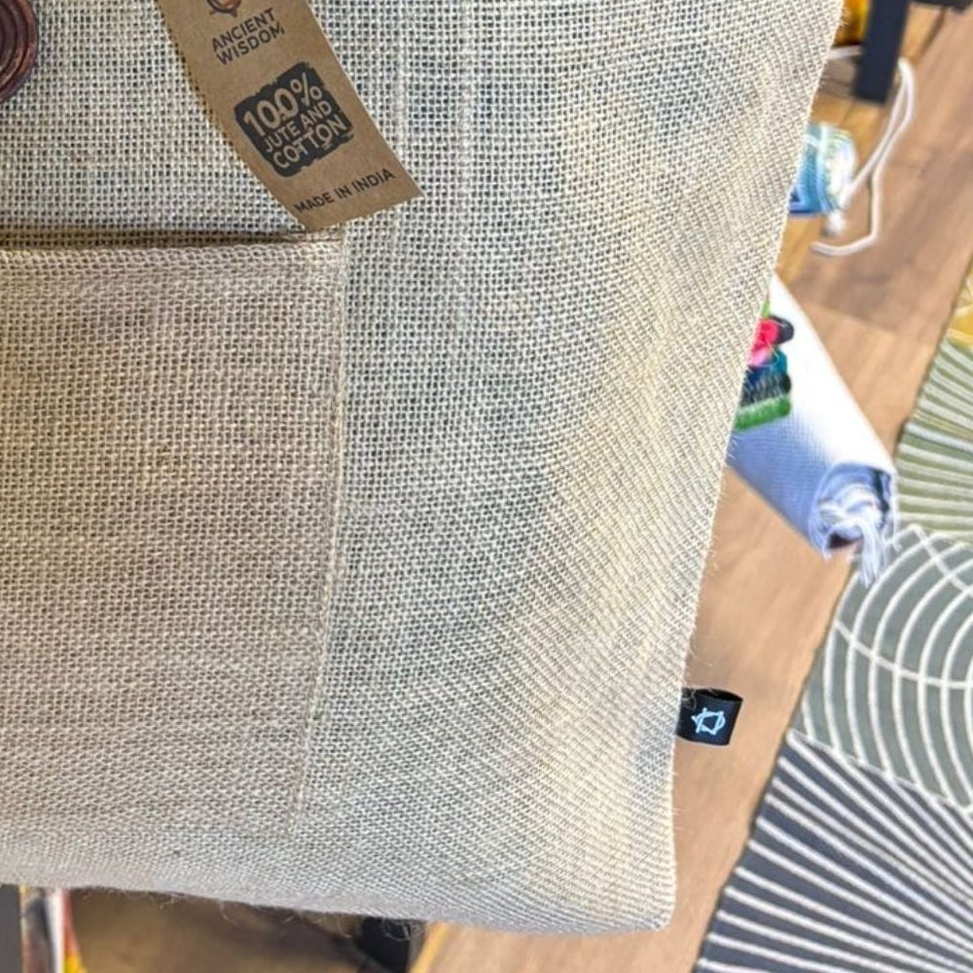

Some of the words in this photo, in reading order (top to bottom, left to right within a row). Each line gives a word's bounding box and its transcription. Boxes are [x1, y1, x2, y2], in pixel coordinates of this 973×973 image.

[212, 8, 275, 52] ANCIENT
[216, 23, 285, 65] WISDOM
[243, 72, 322, 137] 100%
[263, 119, 302, 153] JUTE
[300, 101, 332, 129] AND
[273, 115, 348, 169] COTTON
[293, 192, 332, 214] MADE
[336, 184, 350, 200] IN
[352, 168, 395, 194] INDIA
